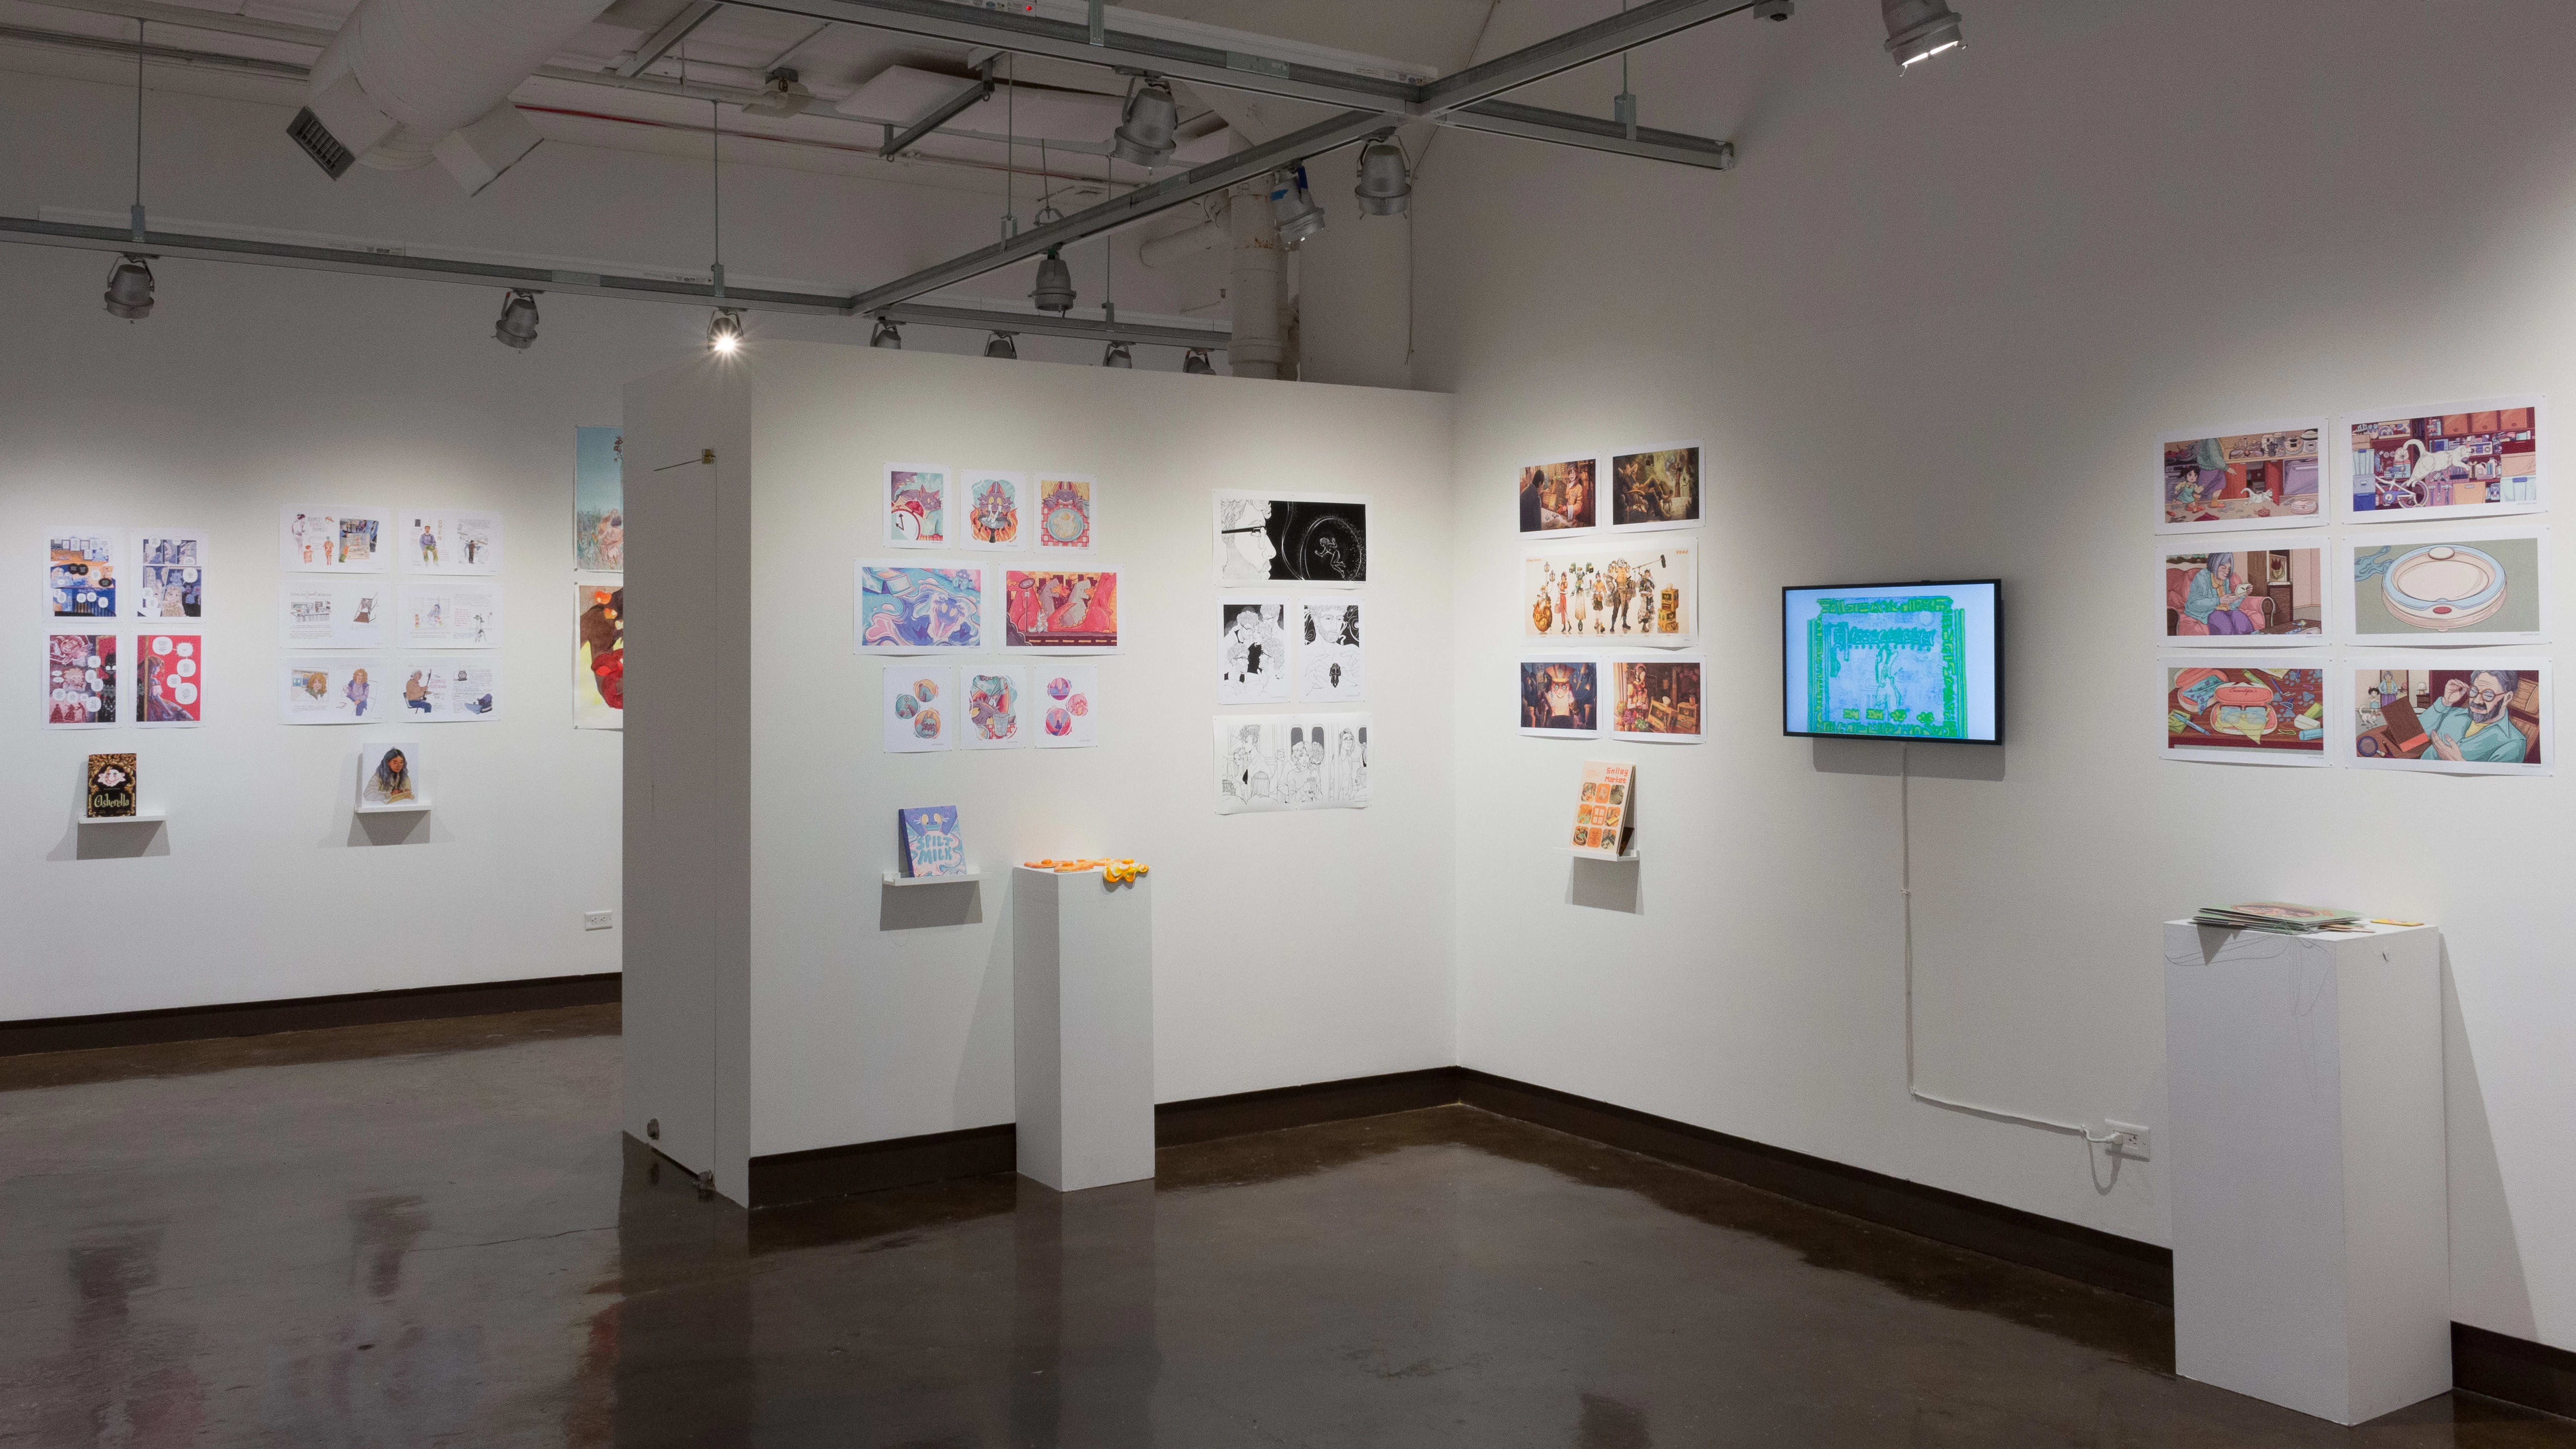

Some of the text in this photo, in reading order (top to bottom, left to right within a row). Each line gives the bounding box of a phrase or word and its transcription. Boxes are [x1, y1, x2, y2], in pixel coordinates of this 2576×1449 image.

[94, 793, 129, 807] Asherella
[916, 834, 953, 850] SPILT
[917, 847, 953, 865] MILK
